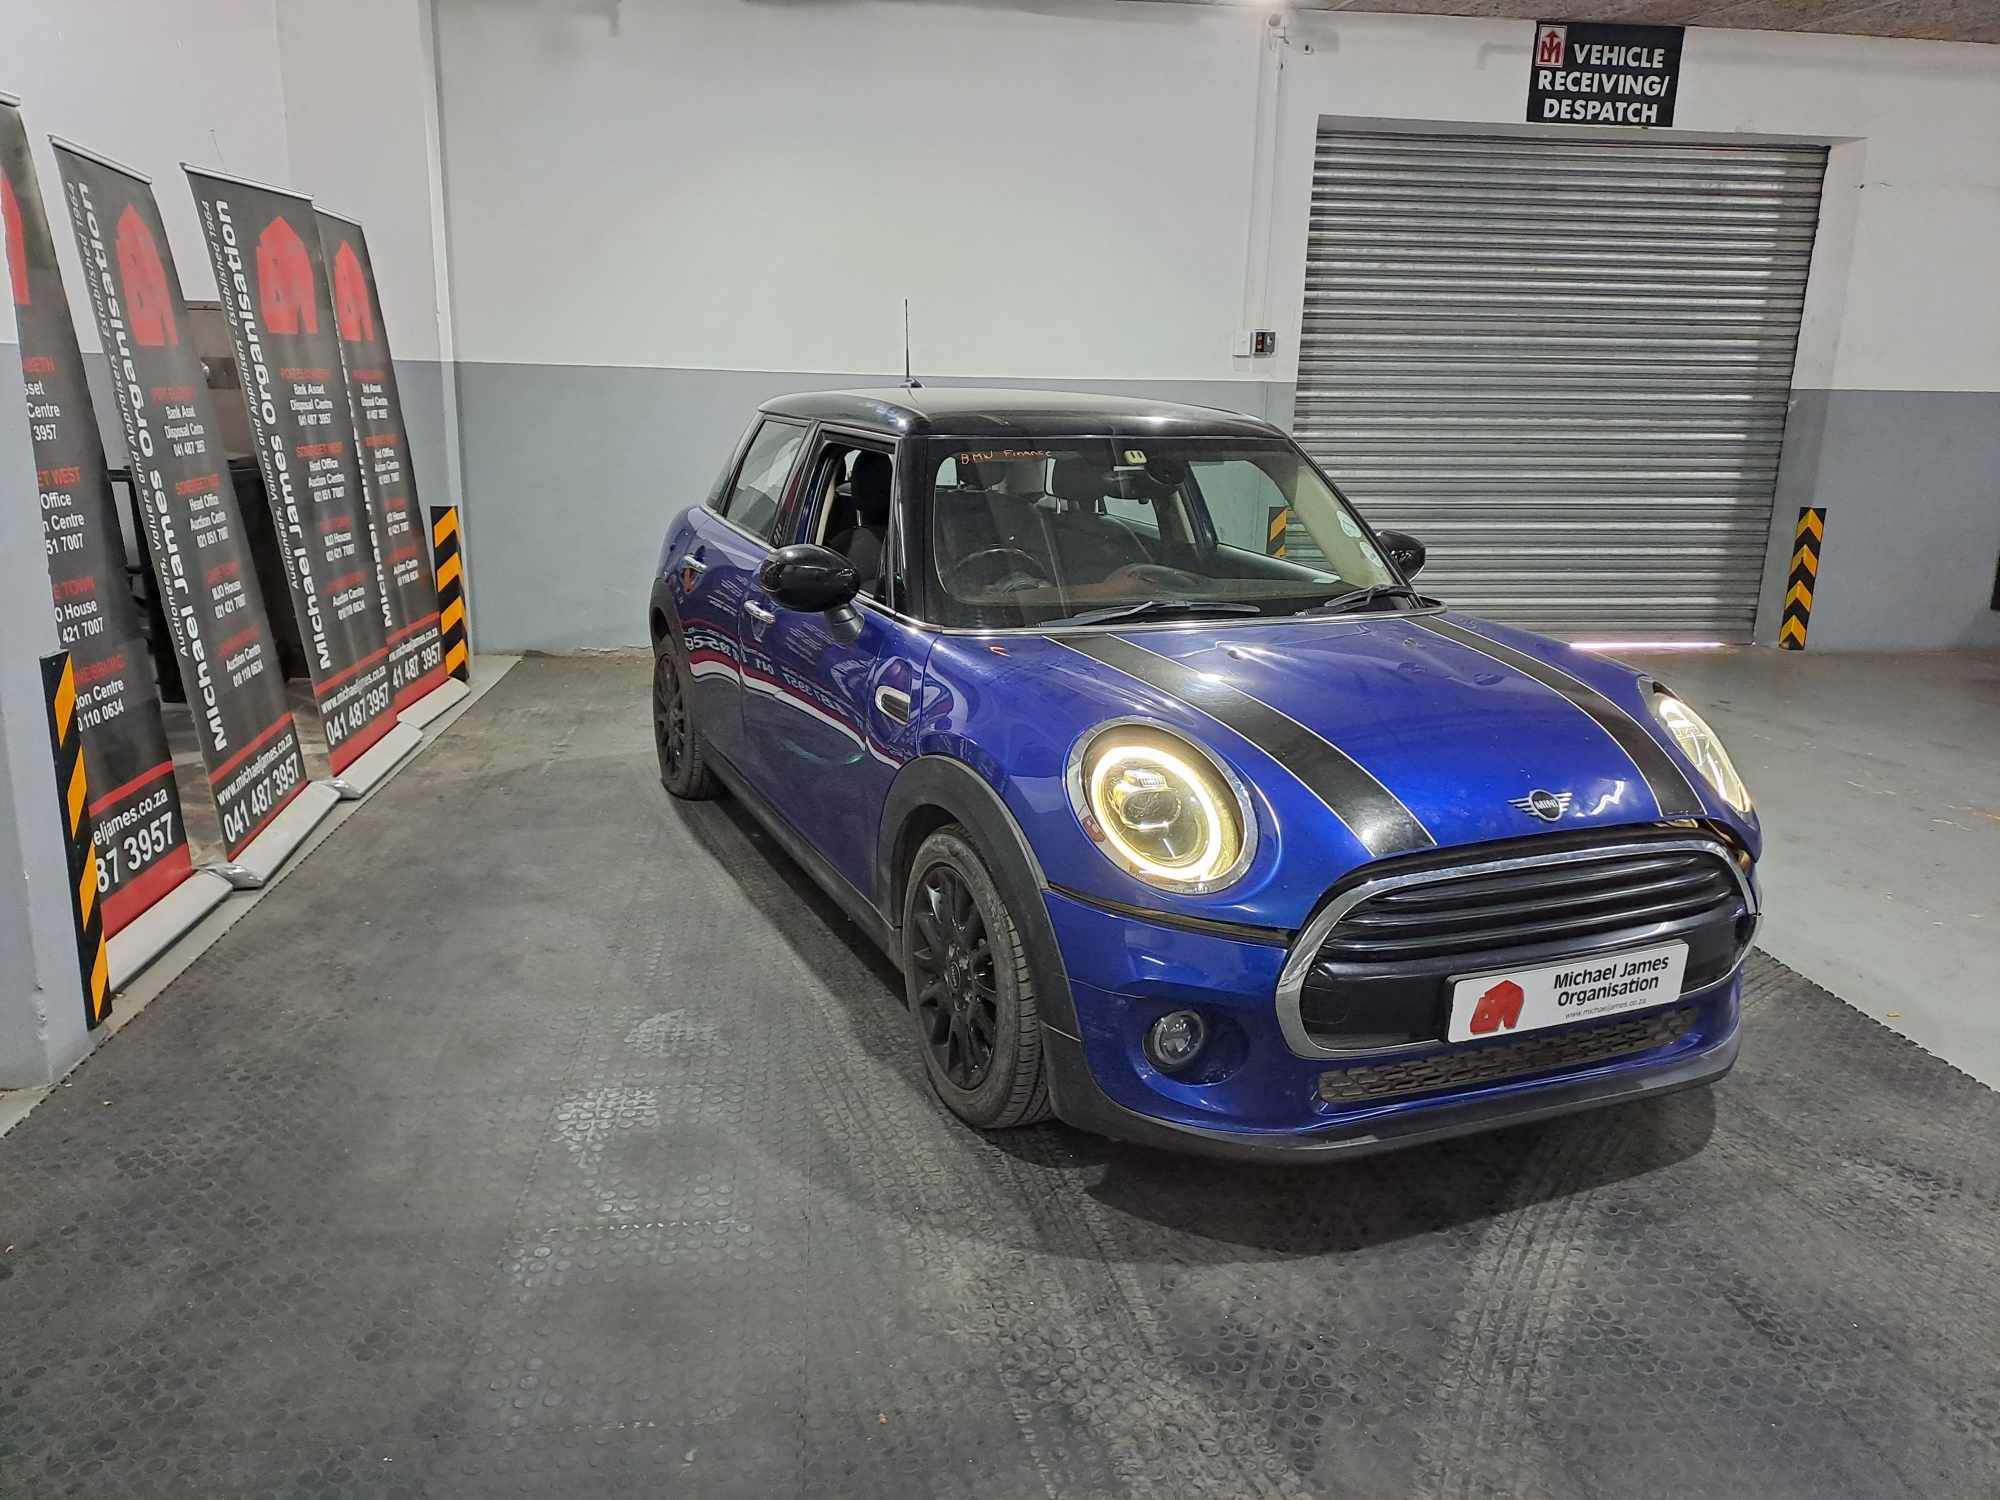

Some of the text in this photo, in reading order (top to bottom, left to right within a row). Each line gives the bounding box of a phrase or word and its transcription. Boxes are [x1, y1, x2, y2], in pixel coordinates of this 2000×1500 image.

[1573, 43, 1665, 69] VEHICLE
[1538, 70, 1671, 97] RECEIVING/
[1543, 98, 1658, 124] DESPATCH
[77, 231, 111, 338] Established
[212, 240, 238, 326] Established
[78, 182, 153, 458] Organisation
[24, 380, 45, 395] sset
[235, 341, 260, 416] Appraisers
[26, 402, 61, 418] Centre
[109, 354, 138, 446] Appraisers
[33, 423, 57, 442] 3957
[216, 200, 331, 670] Michael James Organisation
[254, 425, 266, 446] and
[130, 449, 146, 484] and
[961, 450, 993, 465] BMW
[40, 491, 72, 510] Office
[51, 513, 84, 531] Centre
[142, 487, 162, 550] Valuers
[150, 469, 190, 594] James
[46, 532, 83, 555] 51 7007
[64, 600, 97, 621] House
[62, 617, 104, 643] 421 7007
[180, 605, 228, 751] Michael
[392, 641, 441, 688] 41 487 3957
[93, 679, 125, 699] Centre
[84, 708, 101, 729] 110
[102, 698, 125, 721] 0634
[326, 681, 390, 746] 041 487 3957
[224, 752, 300, 843] 041 487 3957
[1533, 799, 1559, 810] MINI
[92, 788, 169, 847] eljames.co.za
[96, 811, 174, 893] 87 3957
[1553, 956, 1669, 989] Michael James
[1557, 976, 1659, 1006] Organisation
